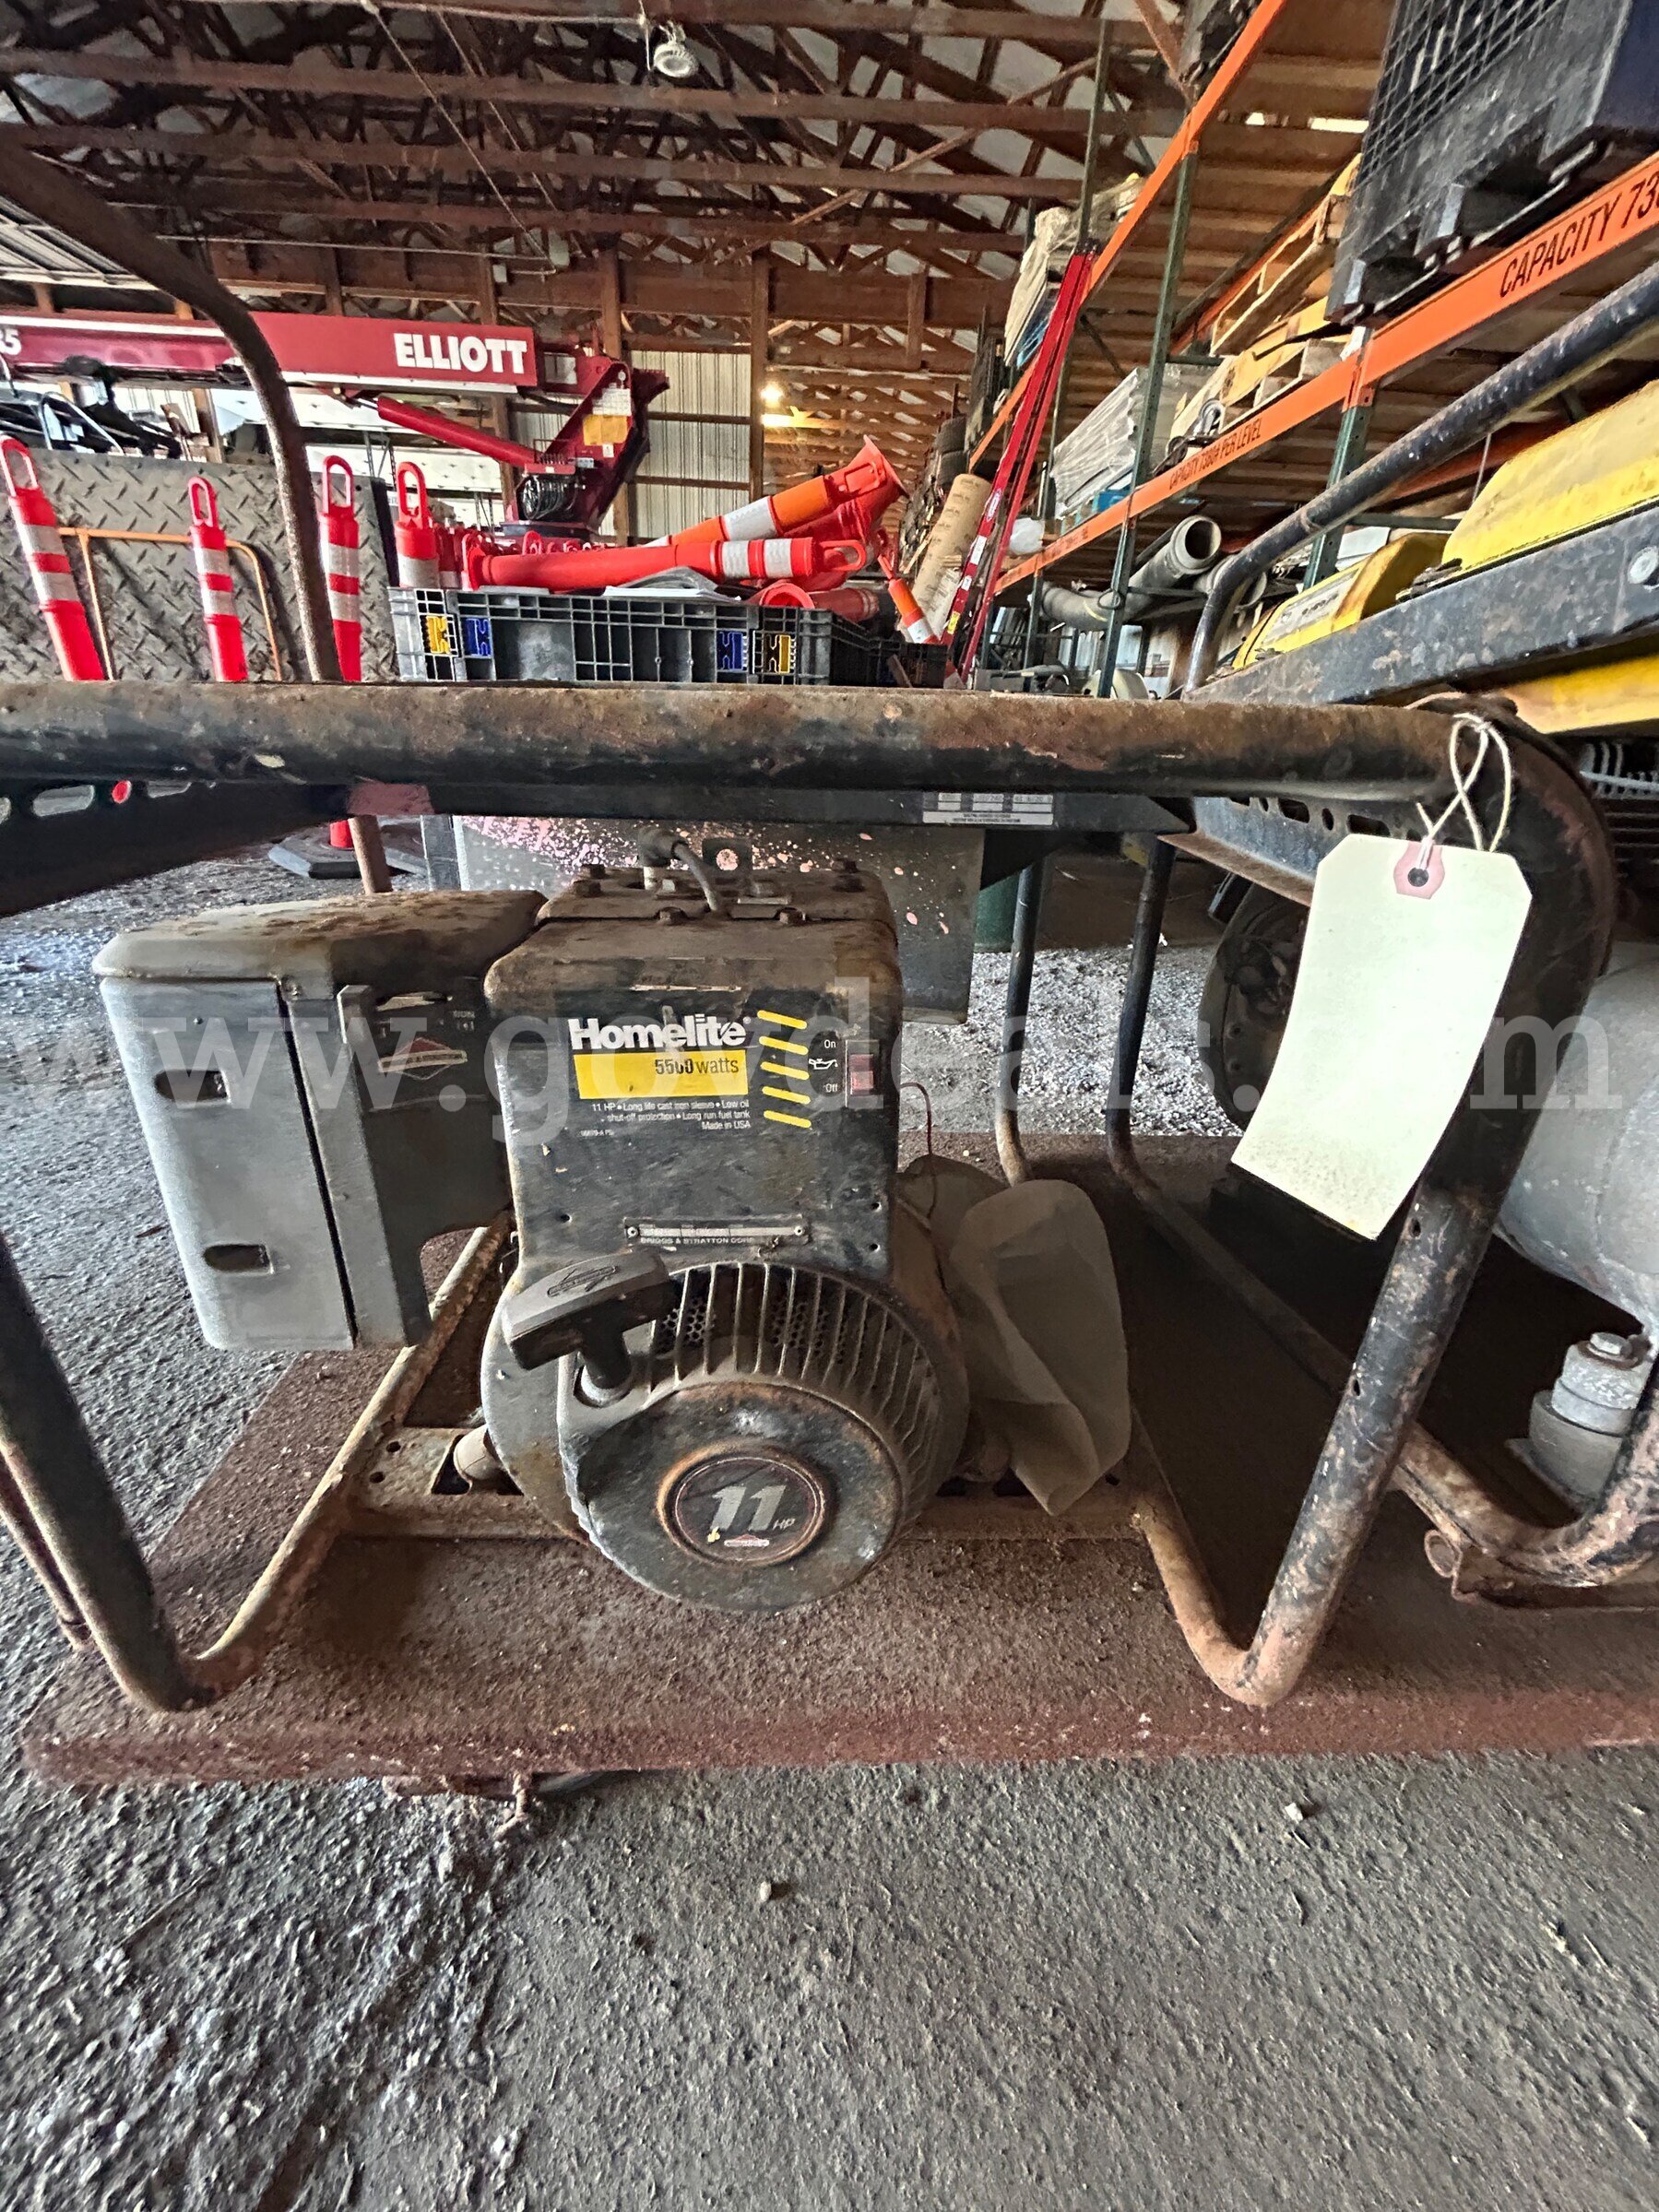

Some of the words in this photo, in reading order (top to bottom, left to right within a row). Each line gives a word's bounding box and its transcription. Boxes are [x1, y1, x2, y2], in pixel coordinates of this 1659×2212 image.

[1500, 191, 1622, 298] CAPACITY
[1621, 172, 1659, 229] 73
[394, 333, 527, 374] ELLIOTT
[1237, 418, 1262, 449] LEVEL
[568, 1013, 746, 1049] Homelite
[824, 1039, 836, 1049] On
[697, 1059, 739, 1075] watts
[825, 1082, 838, 1093] Off
[592, 1103, 601, 1112] 11
[604, 1102, 616, 1111] HP
[623, 1102, 643, 1112] Long
[721, 1098, 738, 1108] Low
[682, 1111, 702, 1121] Long
[702, 1120, 723, 1130] Made
[724, 1120, 732, 1130] in
[733, 1119, 752, 1130] USA
[709, 1485, 787, 1532] 11
[772, 1518, 796, 1531] HP
